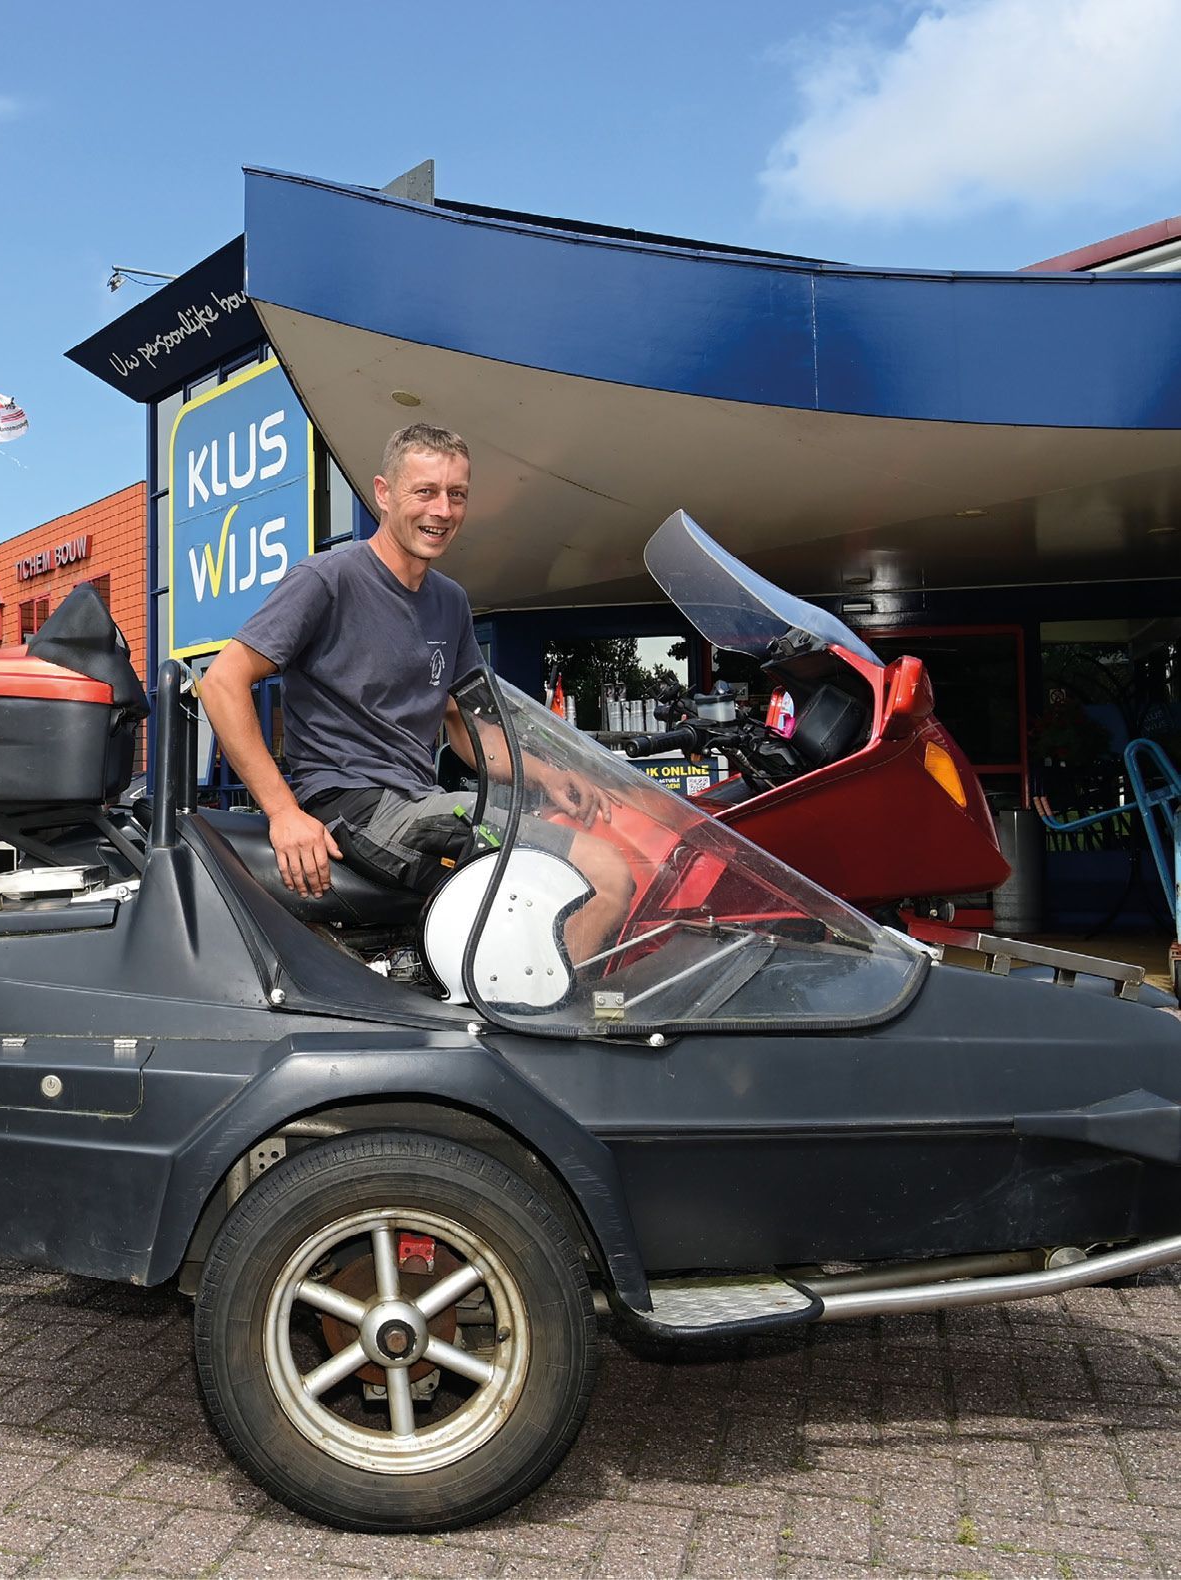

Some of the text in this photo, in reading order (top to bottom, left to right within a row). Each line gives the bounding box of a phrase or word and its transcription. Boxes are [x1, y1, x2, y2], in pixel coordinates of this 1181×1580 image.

[109, 352, 140, 377] Uw
[137, 304, 219, 370] persoonlijke
[188, 410, 287, 508] KLUS
[55, 534, 87, 566] BOUW
[188, 504, 288, 603] WIJS
[662, 764, 709, 776] ONLINE
